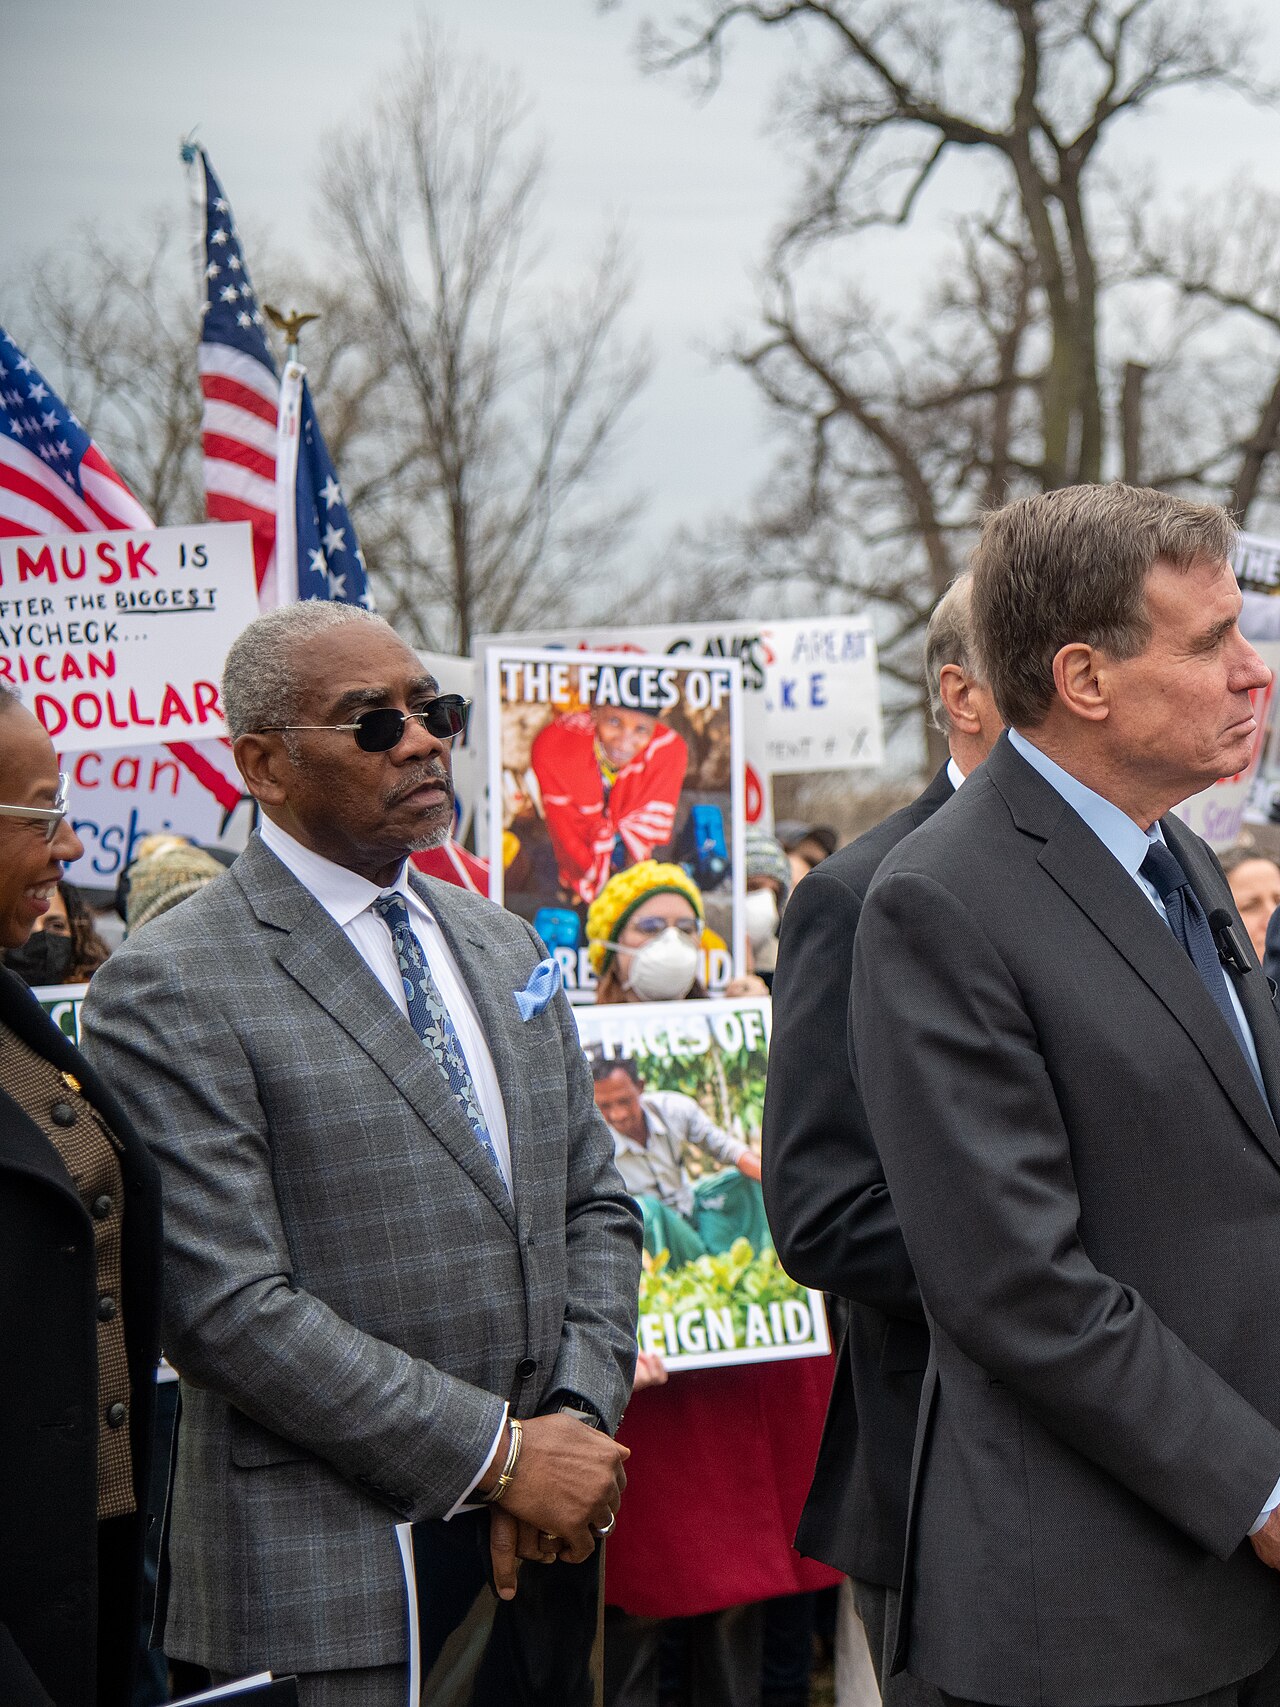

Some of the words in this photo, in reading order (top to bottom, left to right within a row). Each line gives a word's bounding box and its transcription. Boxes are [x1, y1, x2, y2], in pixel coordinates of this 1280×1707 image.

[16, 538, 158, 585] MUSK
[178, 542, 209, 569] IS
[66, 594, 107, 612] THE
[115, 587, 217, 609] BIGGEST
[34, 681, 225, 736] DOLLAR
[502, 662, 572, 704] THE
[577, 666, 681, 709] FACES
[684, 670, 731, 711] OF
[601, 1013, 712, 1062] FACES
[715, 1011, 765, 1053] OF
[746, 1302, 813, 1347] AID
